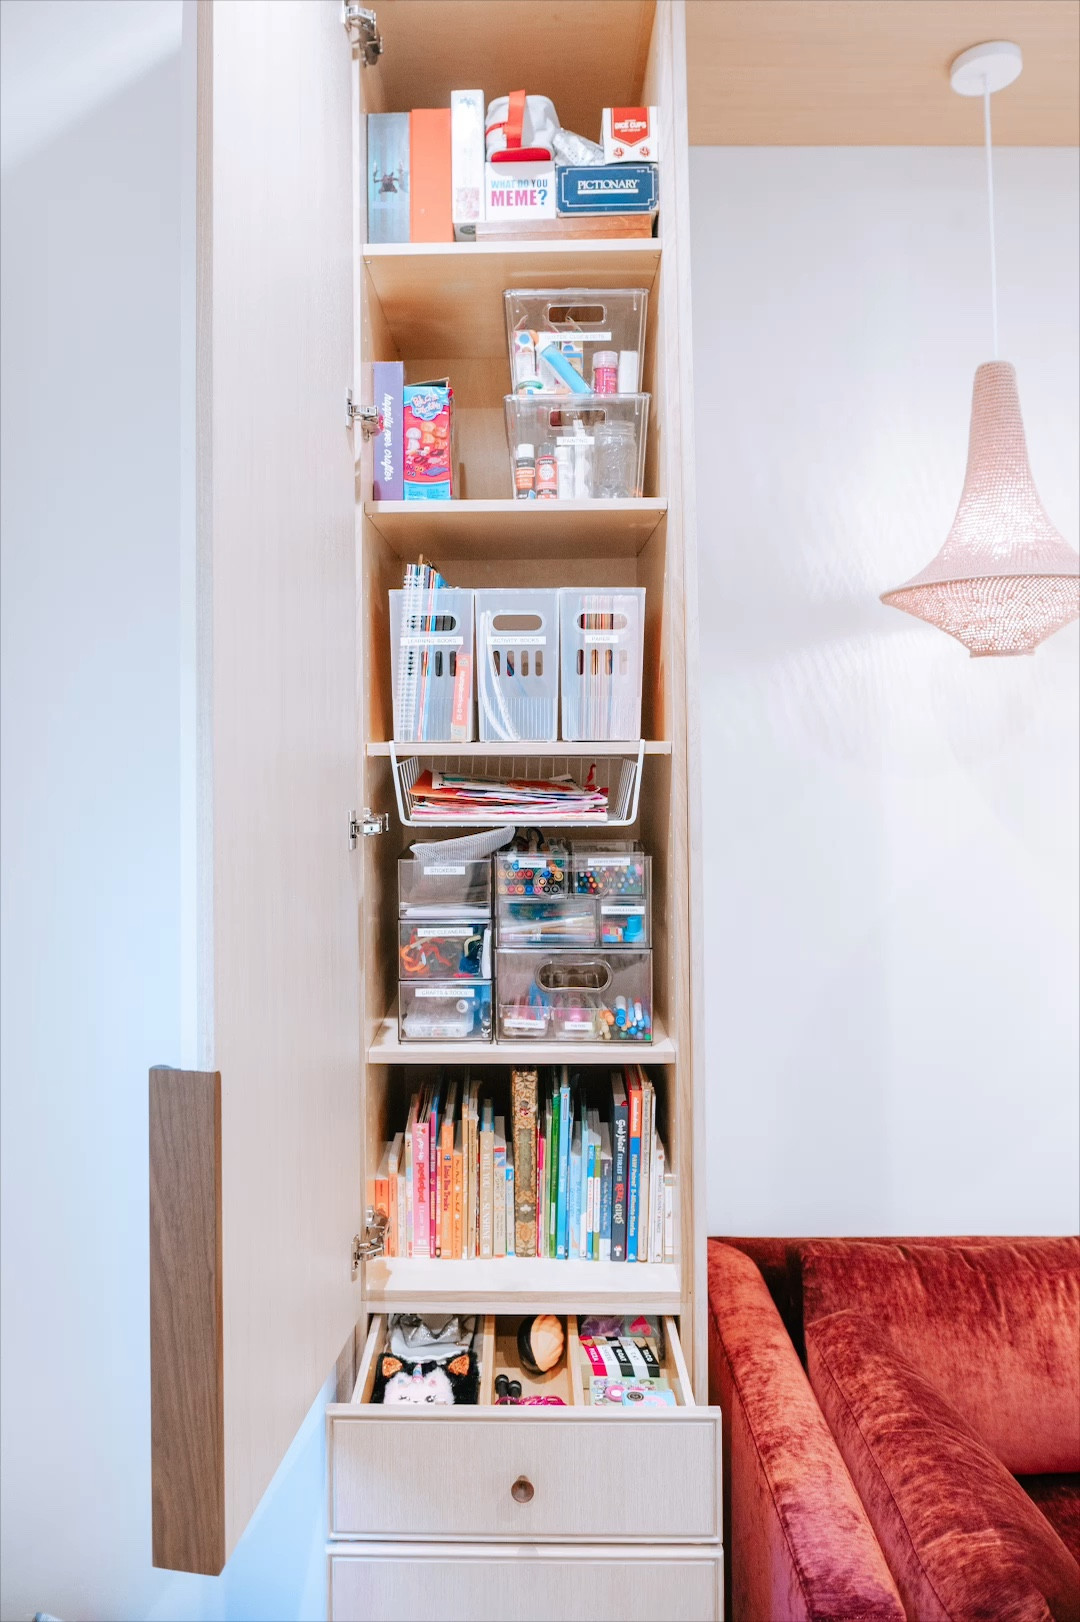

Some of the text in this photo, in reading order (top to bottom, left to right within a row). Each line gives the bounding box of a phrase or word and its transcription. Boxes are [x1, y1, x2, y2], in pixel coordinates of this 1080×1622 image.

[491, 179, 548, 189] WHAT DO YOU
[577, 179, 637, 190] PICTIONARY
[491, 190, 548, 207] MEME?
[382, 393, 395, 428] happily
[381, 449, 394, 482] crafter
[482, 1153, 491, 1169] WILL
[482, 1172, 491, 1187] YOU
[614, 1183, 625, 1203] REBEL
[613, 1203, 625, 1224] GIRLS
[629, 1216, 637, 1237] Stories
